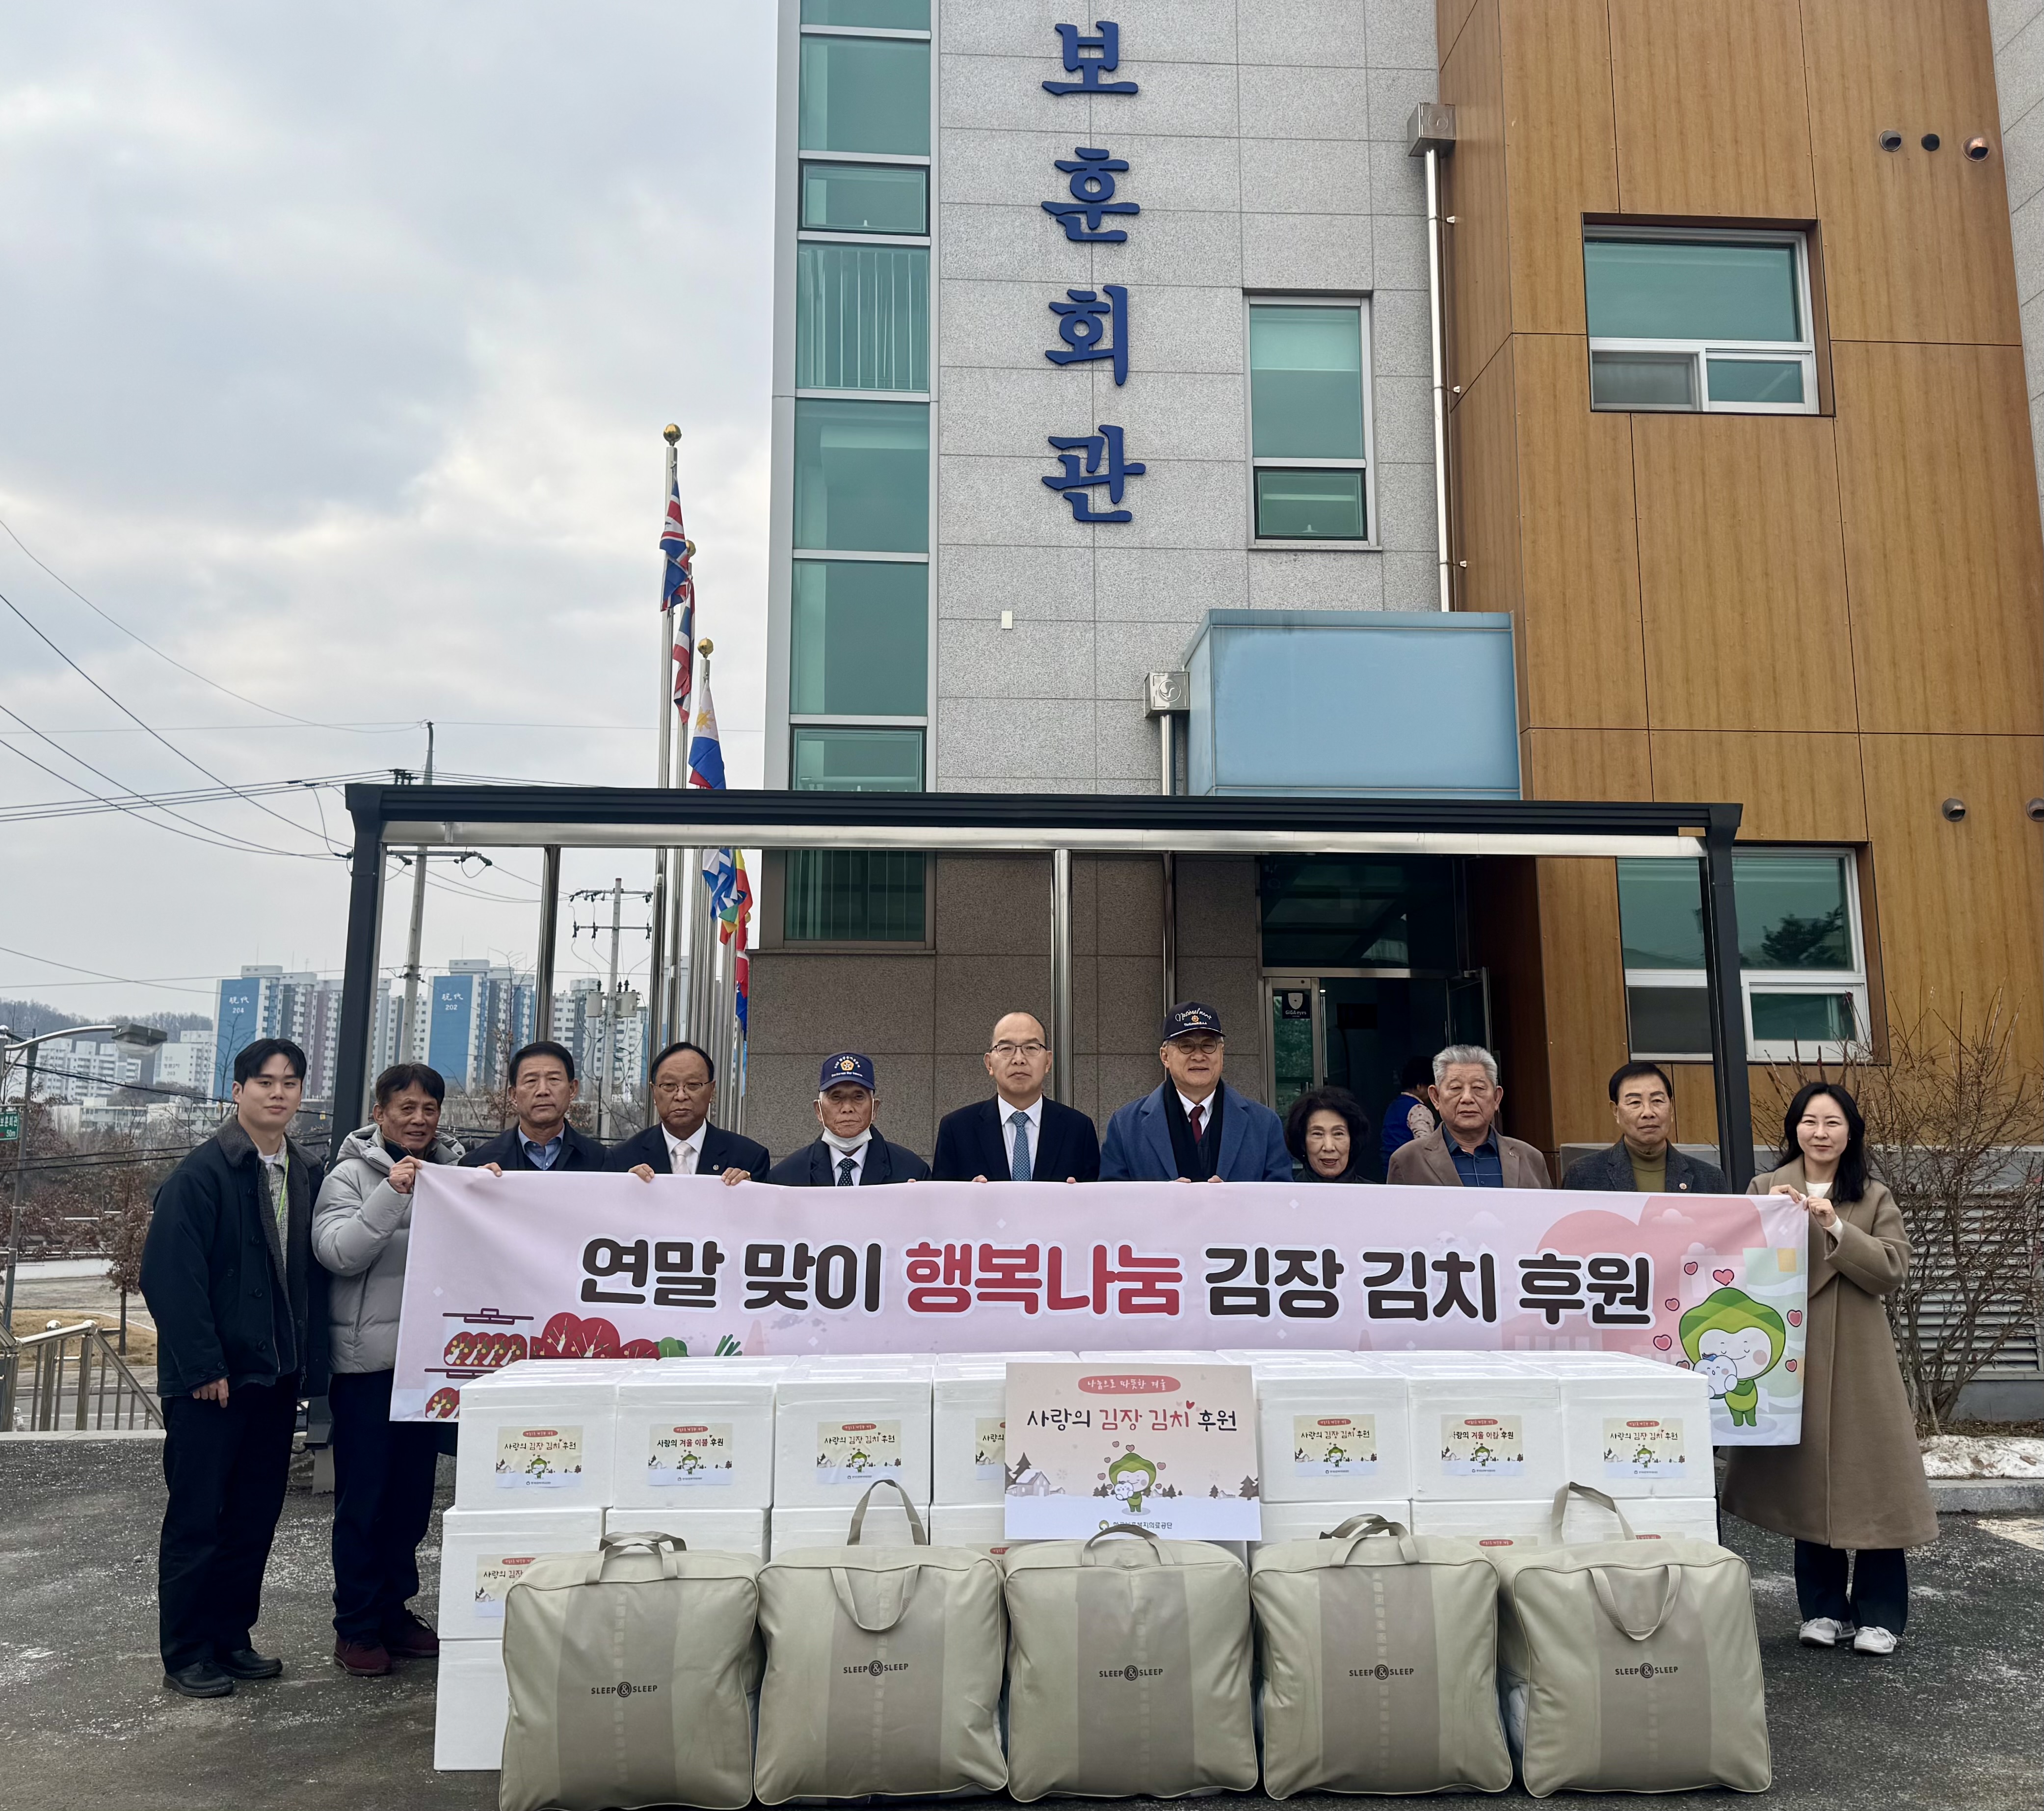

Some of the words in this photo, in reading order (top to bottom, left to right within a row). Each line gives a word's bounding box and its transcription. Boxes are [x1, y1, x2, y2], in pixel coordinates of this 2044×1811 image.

[1041, 21, 1146, 522] 보훈회관
[581, 1238, 725, 1308] 연말
[744, 1242, 881, 1312] 맞이
[906, 1242, 1183, 1315] 행복나눔
[1205, 1247, 1344, 1318] 김장
[1362, 1251, 1497, 1323] 김치
[1518, 1253, 1650, 1325] 후원
[1088, 1379, 1116, 1390] 나눔으로
[1120, 1378, 1146, 1389] 따뜻한
[1151, 1379, 1166, 1390] 겨울
[1027, 1409, 1090, 1431] 사랑의
[1099, 1409, 1142, 1430] 김장
[1149, 1409, 1189, 1430] 김치
[1197, 1410, 1237, 1432] 후원
[982, 1434, 1004, 1442] 사랑의
[1301, 1431, 1322, 1439] 사랑의
[1610, 1432, 1631, 1440] 사랑의
[824, 1437, 846, 1445] 사랑의
[504, 1442, 526, 1451] 사랑의
[483, 1571, 505, 1579] 사랑의
